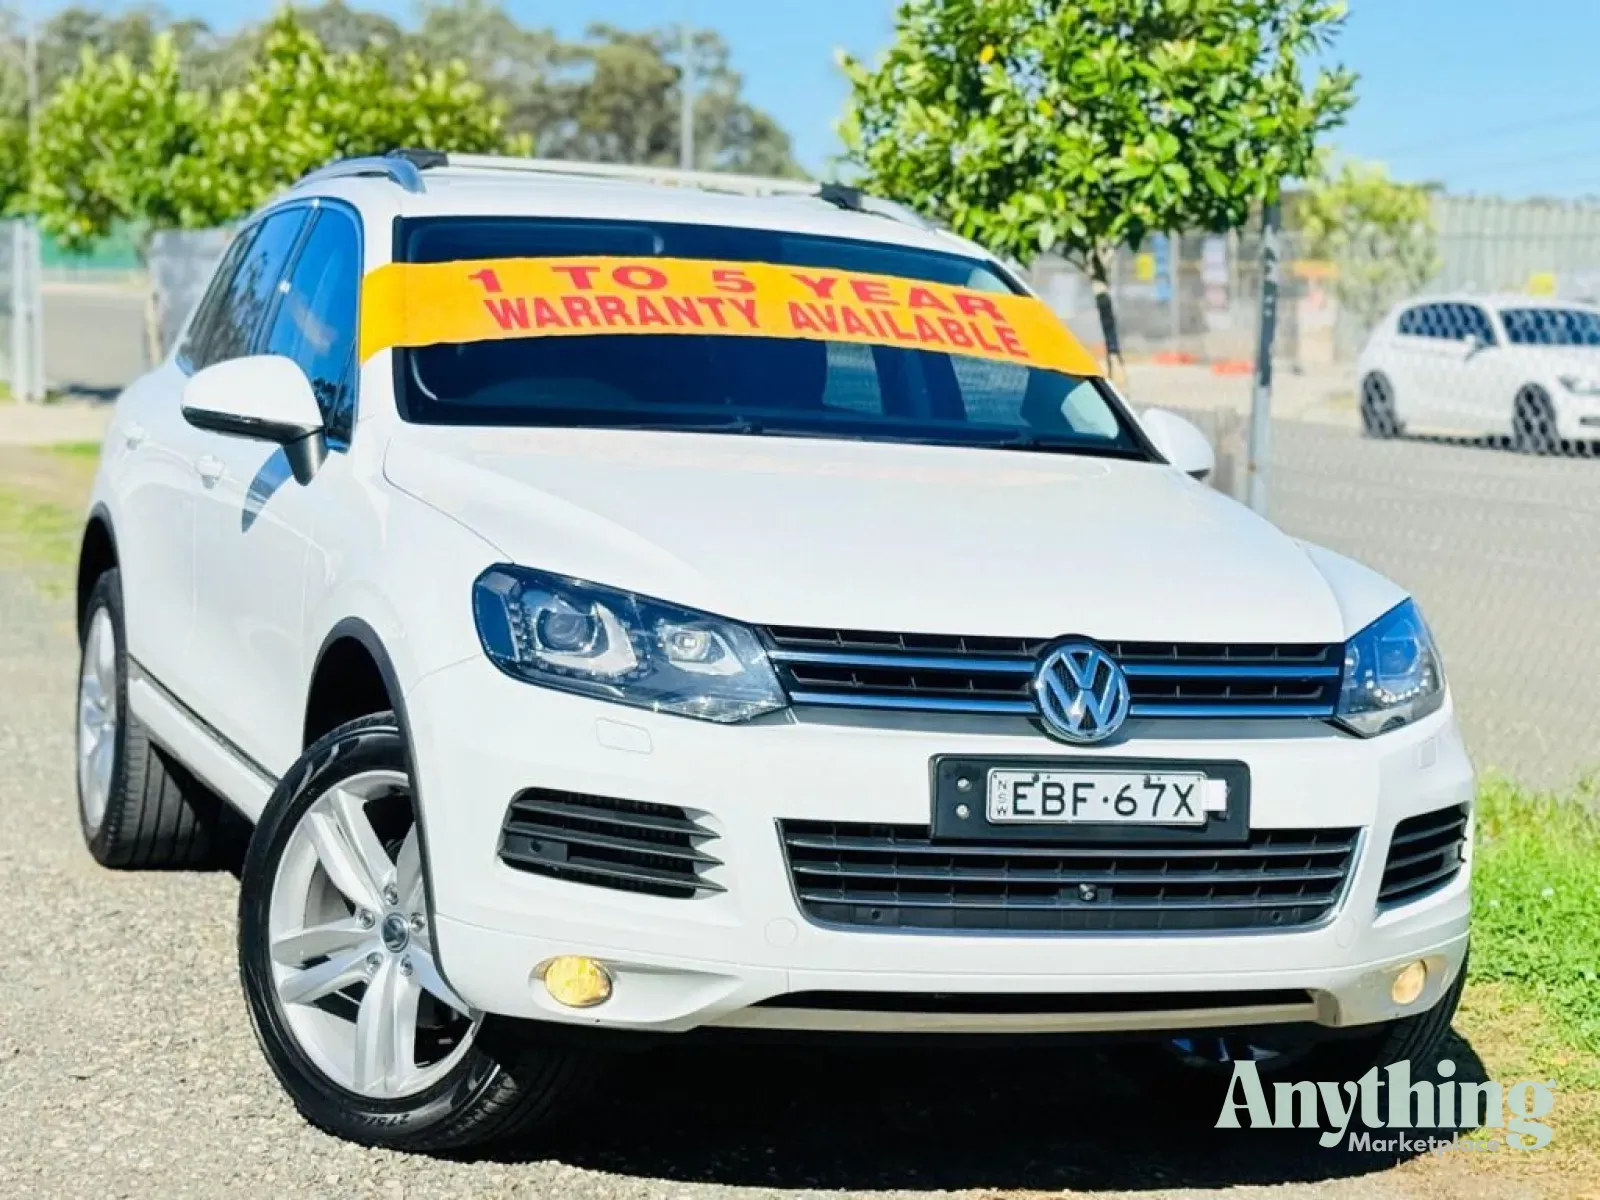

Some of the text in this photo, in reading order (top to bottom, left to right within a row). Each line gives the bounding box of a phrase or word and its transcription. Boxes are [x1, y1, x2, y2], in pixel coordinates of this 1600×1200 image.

[468, 265, 1005, 322] 1 TO 5 YEAR
[483, 295, 1030, 358] WARRANTY AVAILABLE
